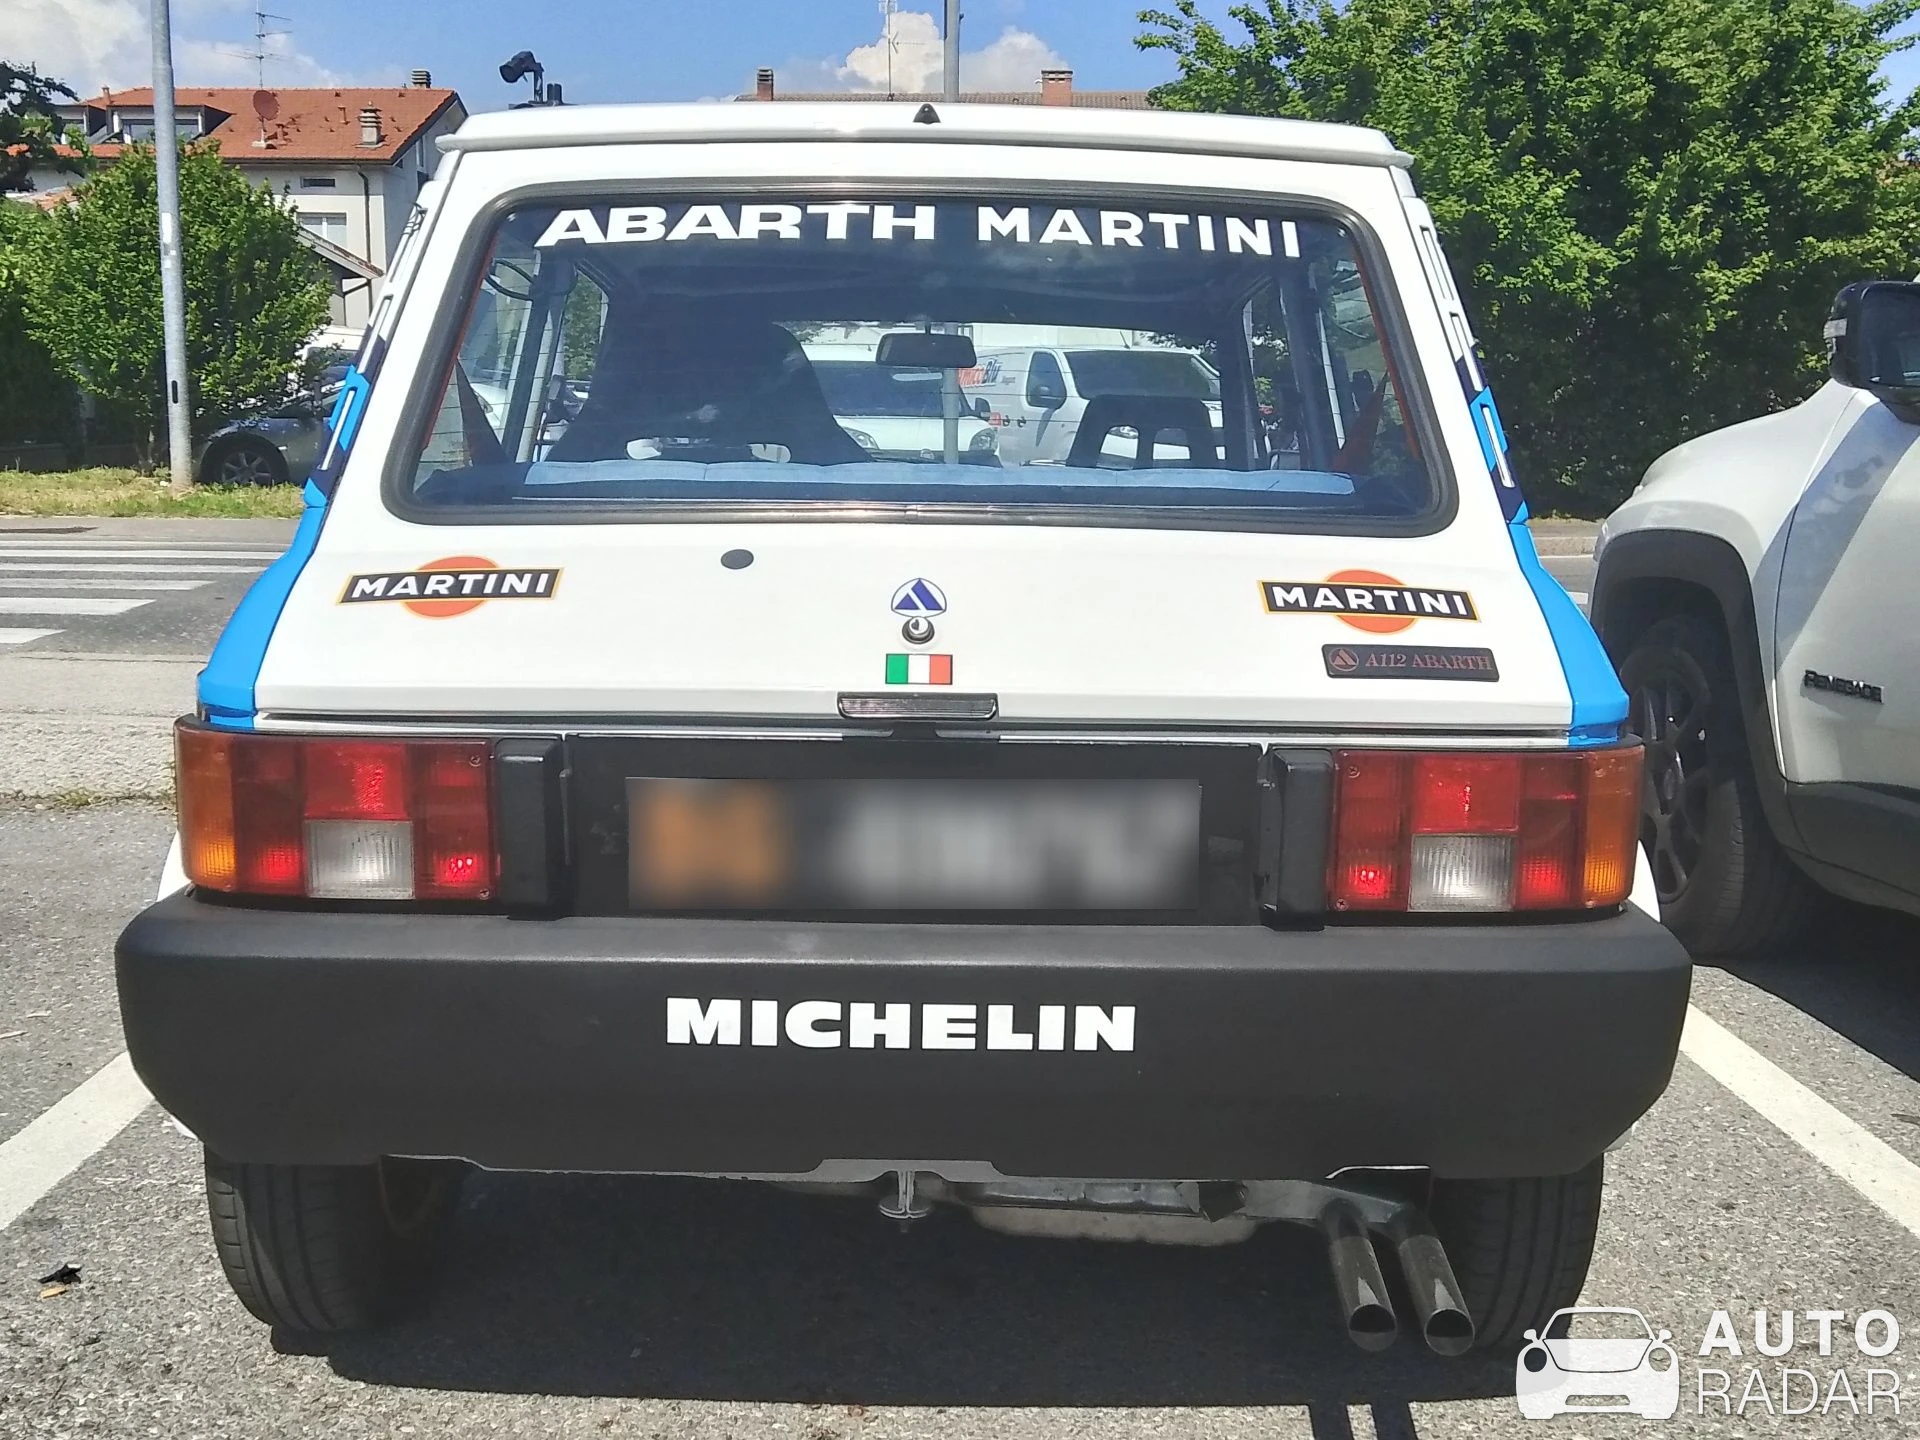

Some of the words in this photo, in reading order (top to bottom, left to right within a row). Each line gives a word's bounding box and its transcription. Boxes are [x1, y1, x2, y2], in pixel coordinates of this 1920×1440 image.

[534, 204, 936, 248] ABARTH
[977, 206, 1301, 257] MARTINI
[350, 573, 550, 599] MARTINI
[1271, 586, 1469, 616] MARTINI
[1365, 652, 1407, 668] A112
[1412, 655, 1494, 671] ABARTH
[1803, 669, 1884, 703] RENEGADE
[666, 997, 1136, 1052] MICHELIN
